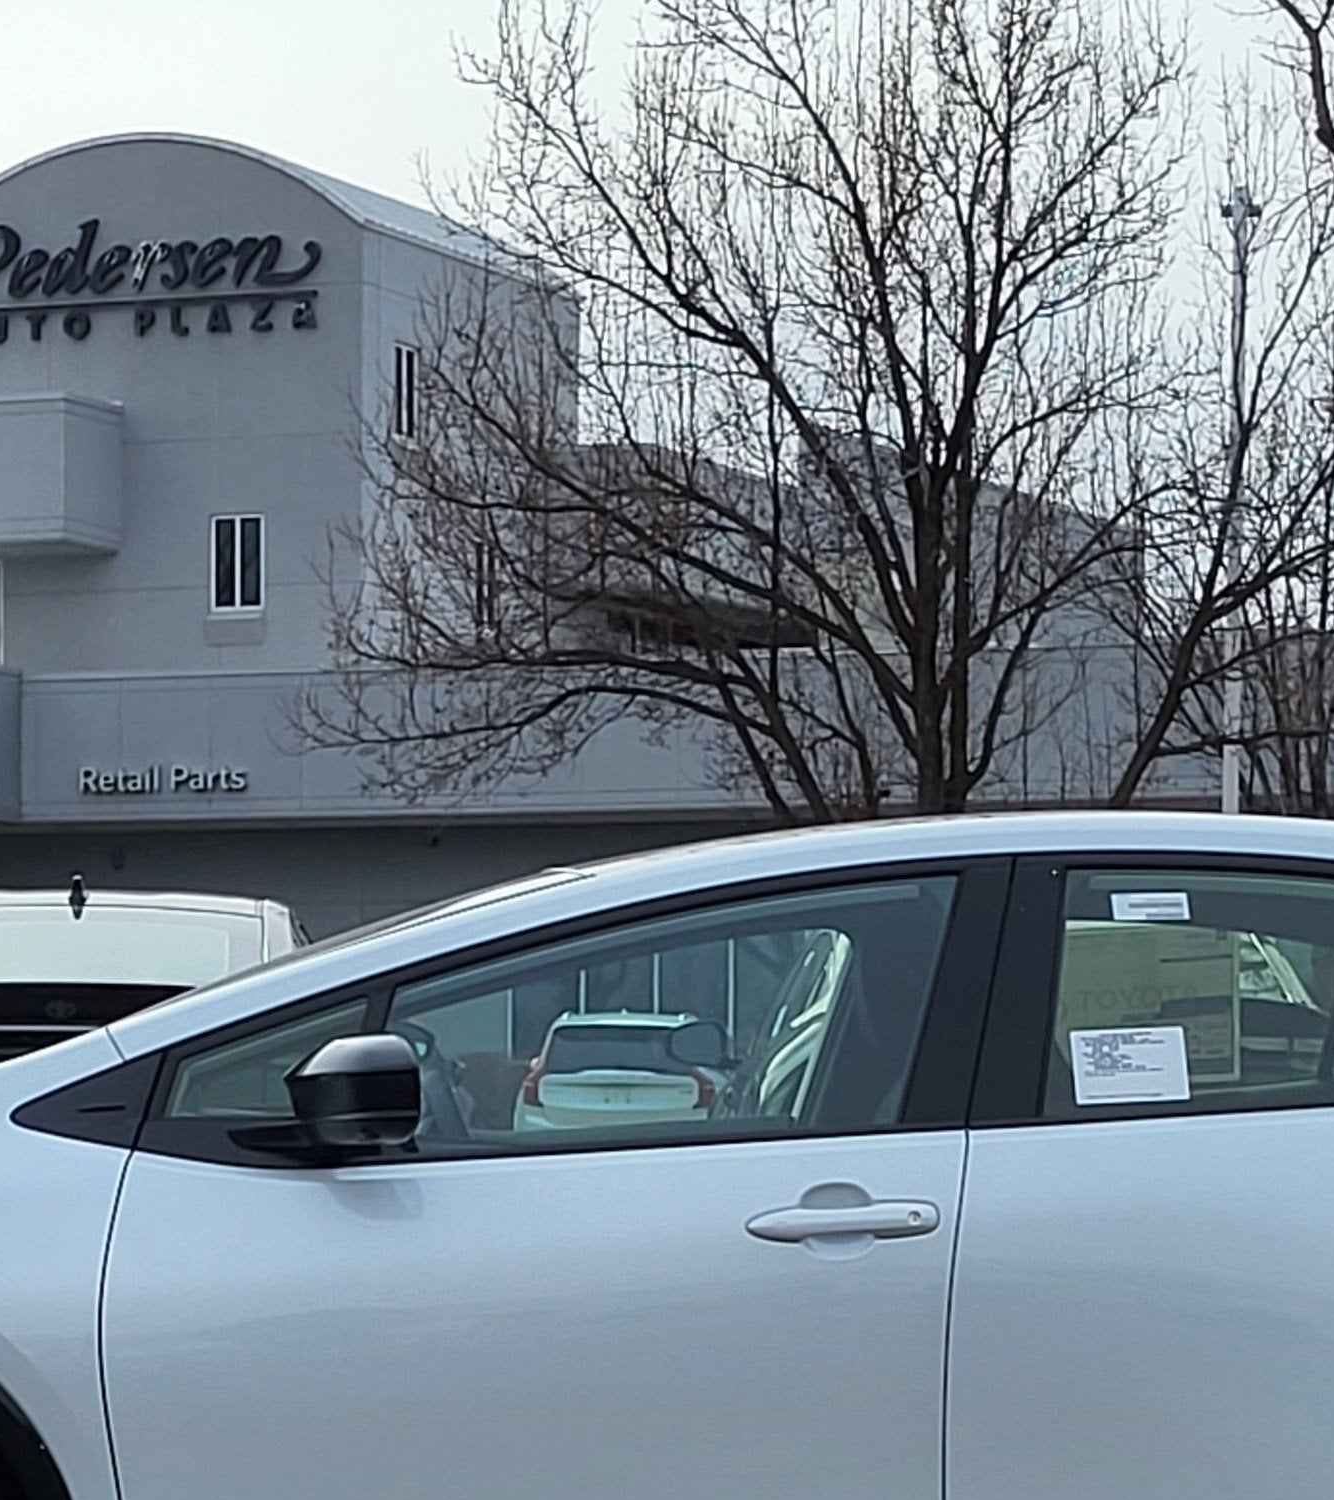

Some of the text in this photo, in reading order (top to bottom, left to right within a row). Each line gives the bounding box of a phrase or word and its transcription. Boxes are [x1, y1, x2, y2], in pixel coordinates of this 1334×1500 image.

[133, 299, 320, 338] PLAZA
[78, 764, 248, 793] Retail Parts
